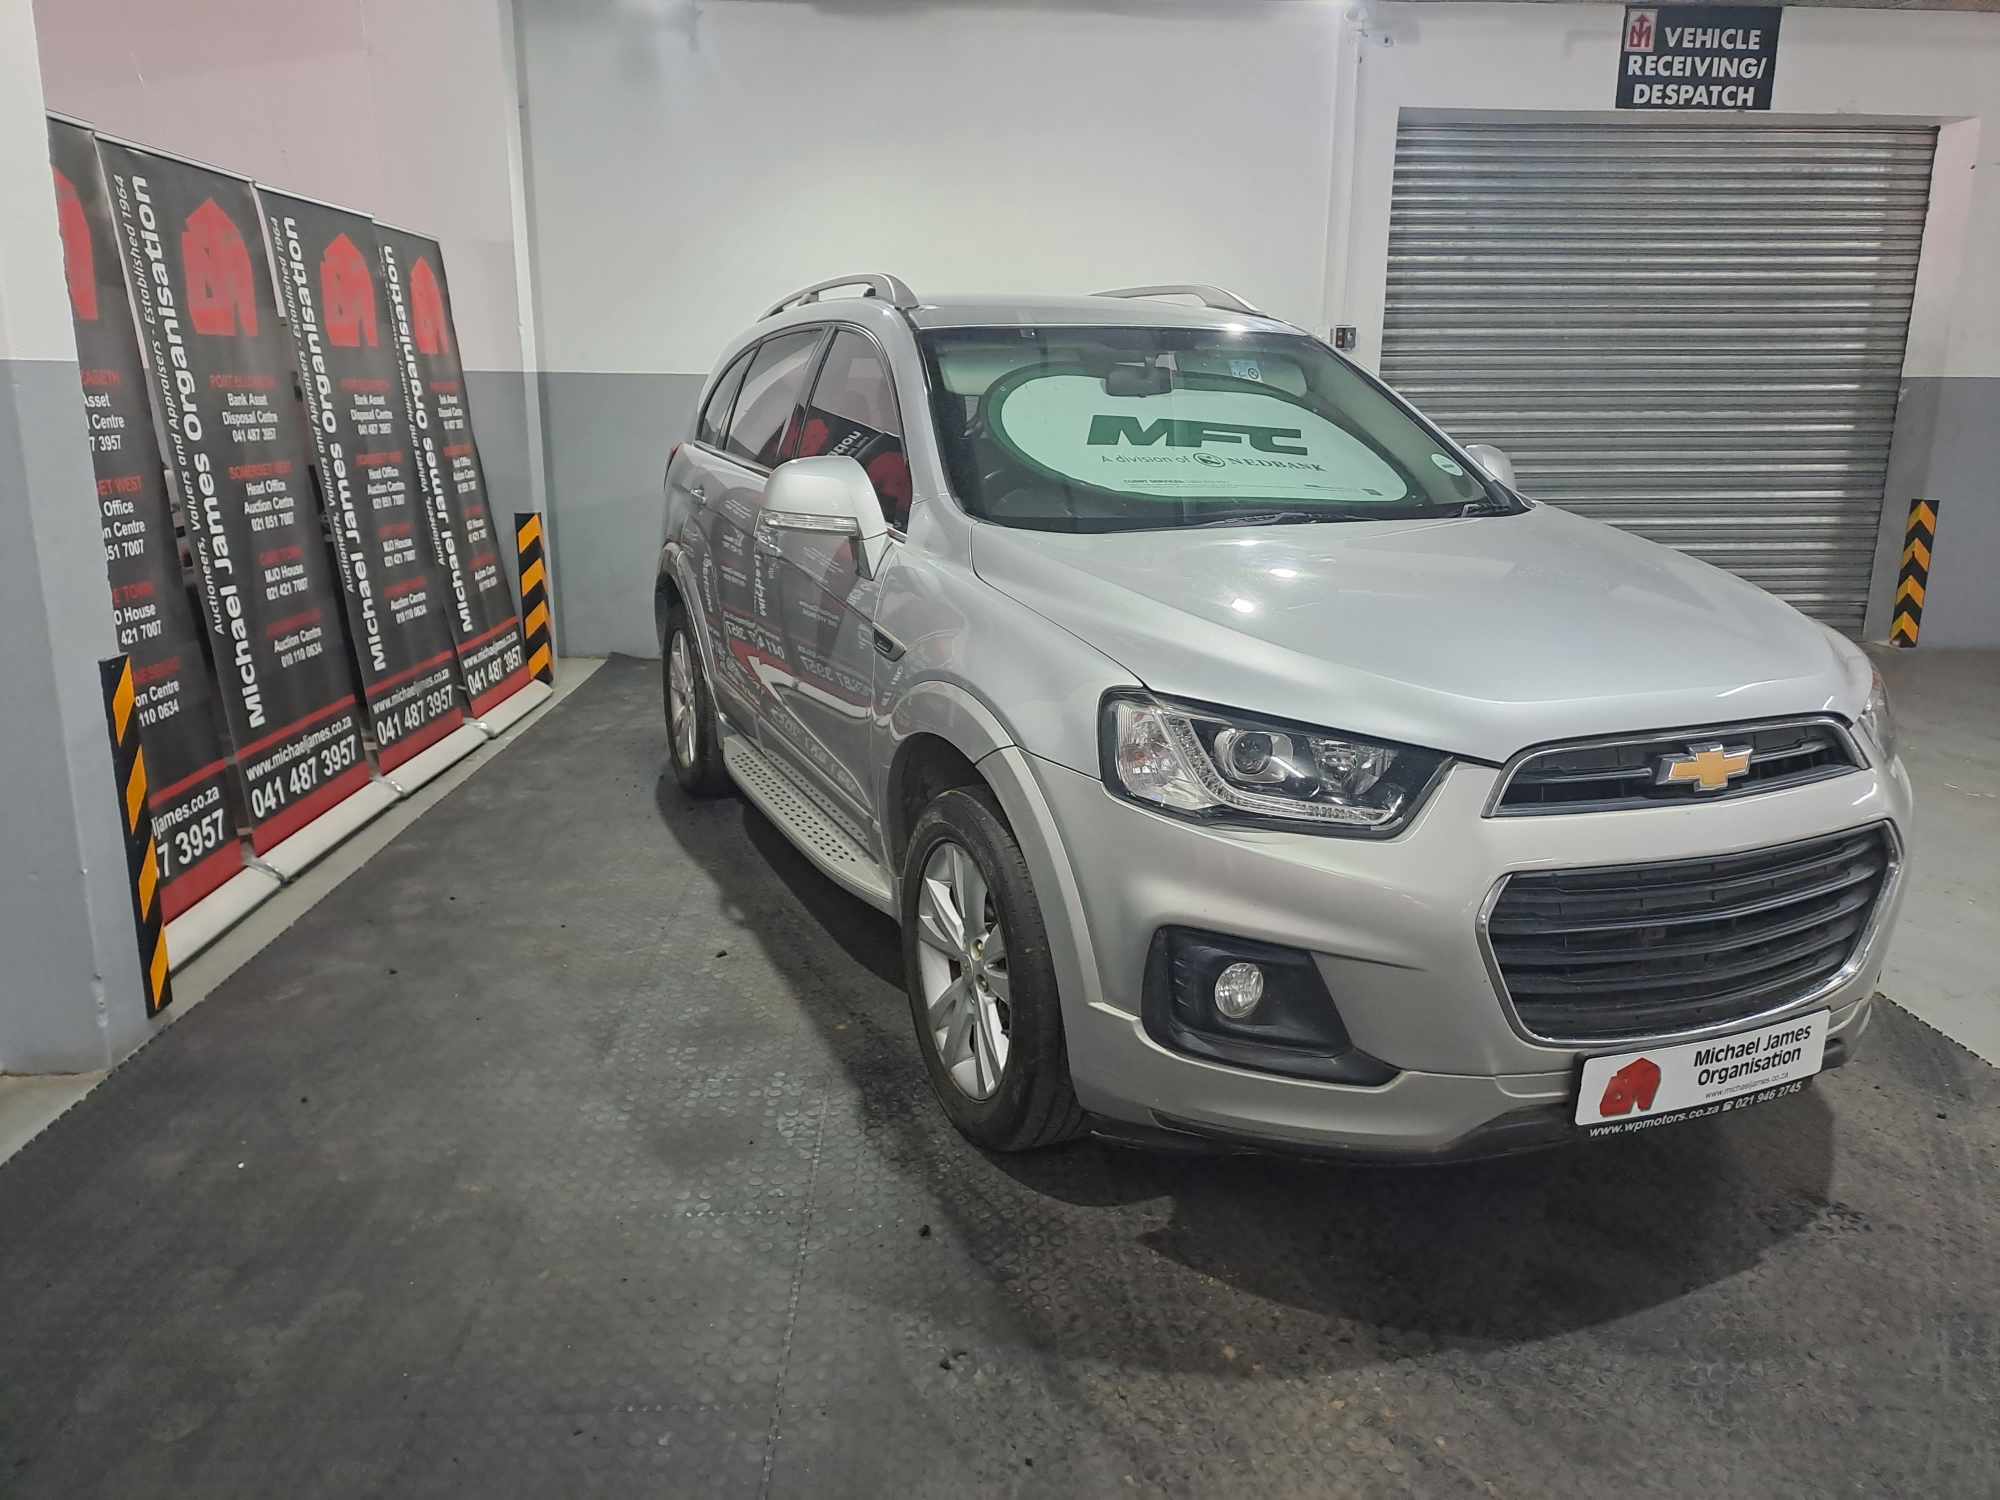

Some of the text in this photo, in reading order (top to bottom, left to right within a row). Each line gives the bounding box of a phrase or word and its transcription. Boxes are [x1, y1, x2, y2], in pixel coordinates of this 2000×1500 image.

[1664, 26, 1761, 50] VEHICLE
[1627, 55, 1767, 79] RECEIVING/
[1632, 83, 1755, 107] DESPATCH
[113, 174, 132, 218] 1964
[123, 223, 155, 324] Established
[384, 245, 428, 430] Organisation
[152, 340, 179, 429] Appraisers
[91, 414, 125, 430] Centre
[313, 426, 325, 453] and
[1087, 414, 1308, 456] MFC
[98, 434, 121, 451] 3957
[132, 175, 266, 728] Michael James Organisation
[170, 433, 187, 466] and
[283, 217, 386, 671] Michael James Organisation
[423, 437, 448, 524] James
[1101, 454, 1328, 472] A division of NEDBANK
[103, 499, 134, 517] Office
[181, 471, 201, 530] Valuers
[244, 499, 272, 515] Auction
[113, 520, 146, 537] Centre
[122, 538, 144, 557] 7007
[441, 531, 472, 633] Michael
[120, 619, 162, 645] 421 7007
[124, 603, 157, 623] House
[466, 644, 523, 696] 041 487 3957
[149, 680, 180, 700] Centre
[158, 699, 179, 720] 0634
[376, 684, 453, 745] 041 487 3957
[251, 734, 356, 818] 041 487 3957
[175, 808, 224, 864] 3957
[1693, 1025, 1811, 1067] Michael James
[1697, 1047, 1801, 1086] Organisation
[1589, 1104, 1719, 1137] www.wpmotors.co.za
[1735, 1095, 1754, 1109] 021
[1777, 1081, 1802, 1097] 2745
